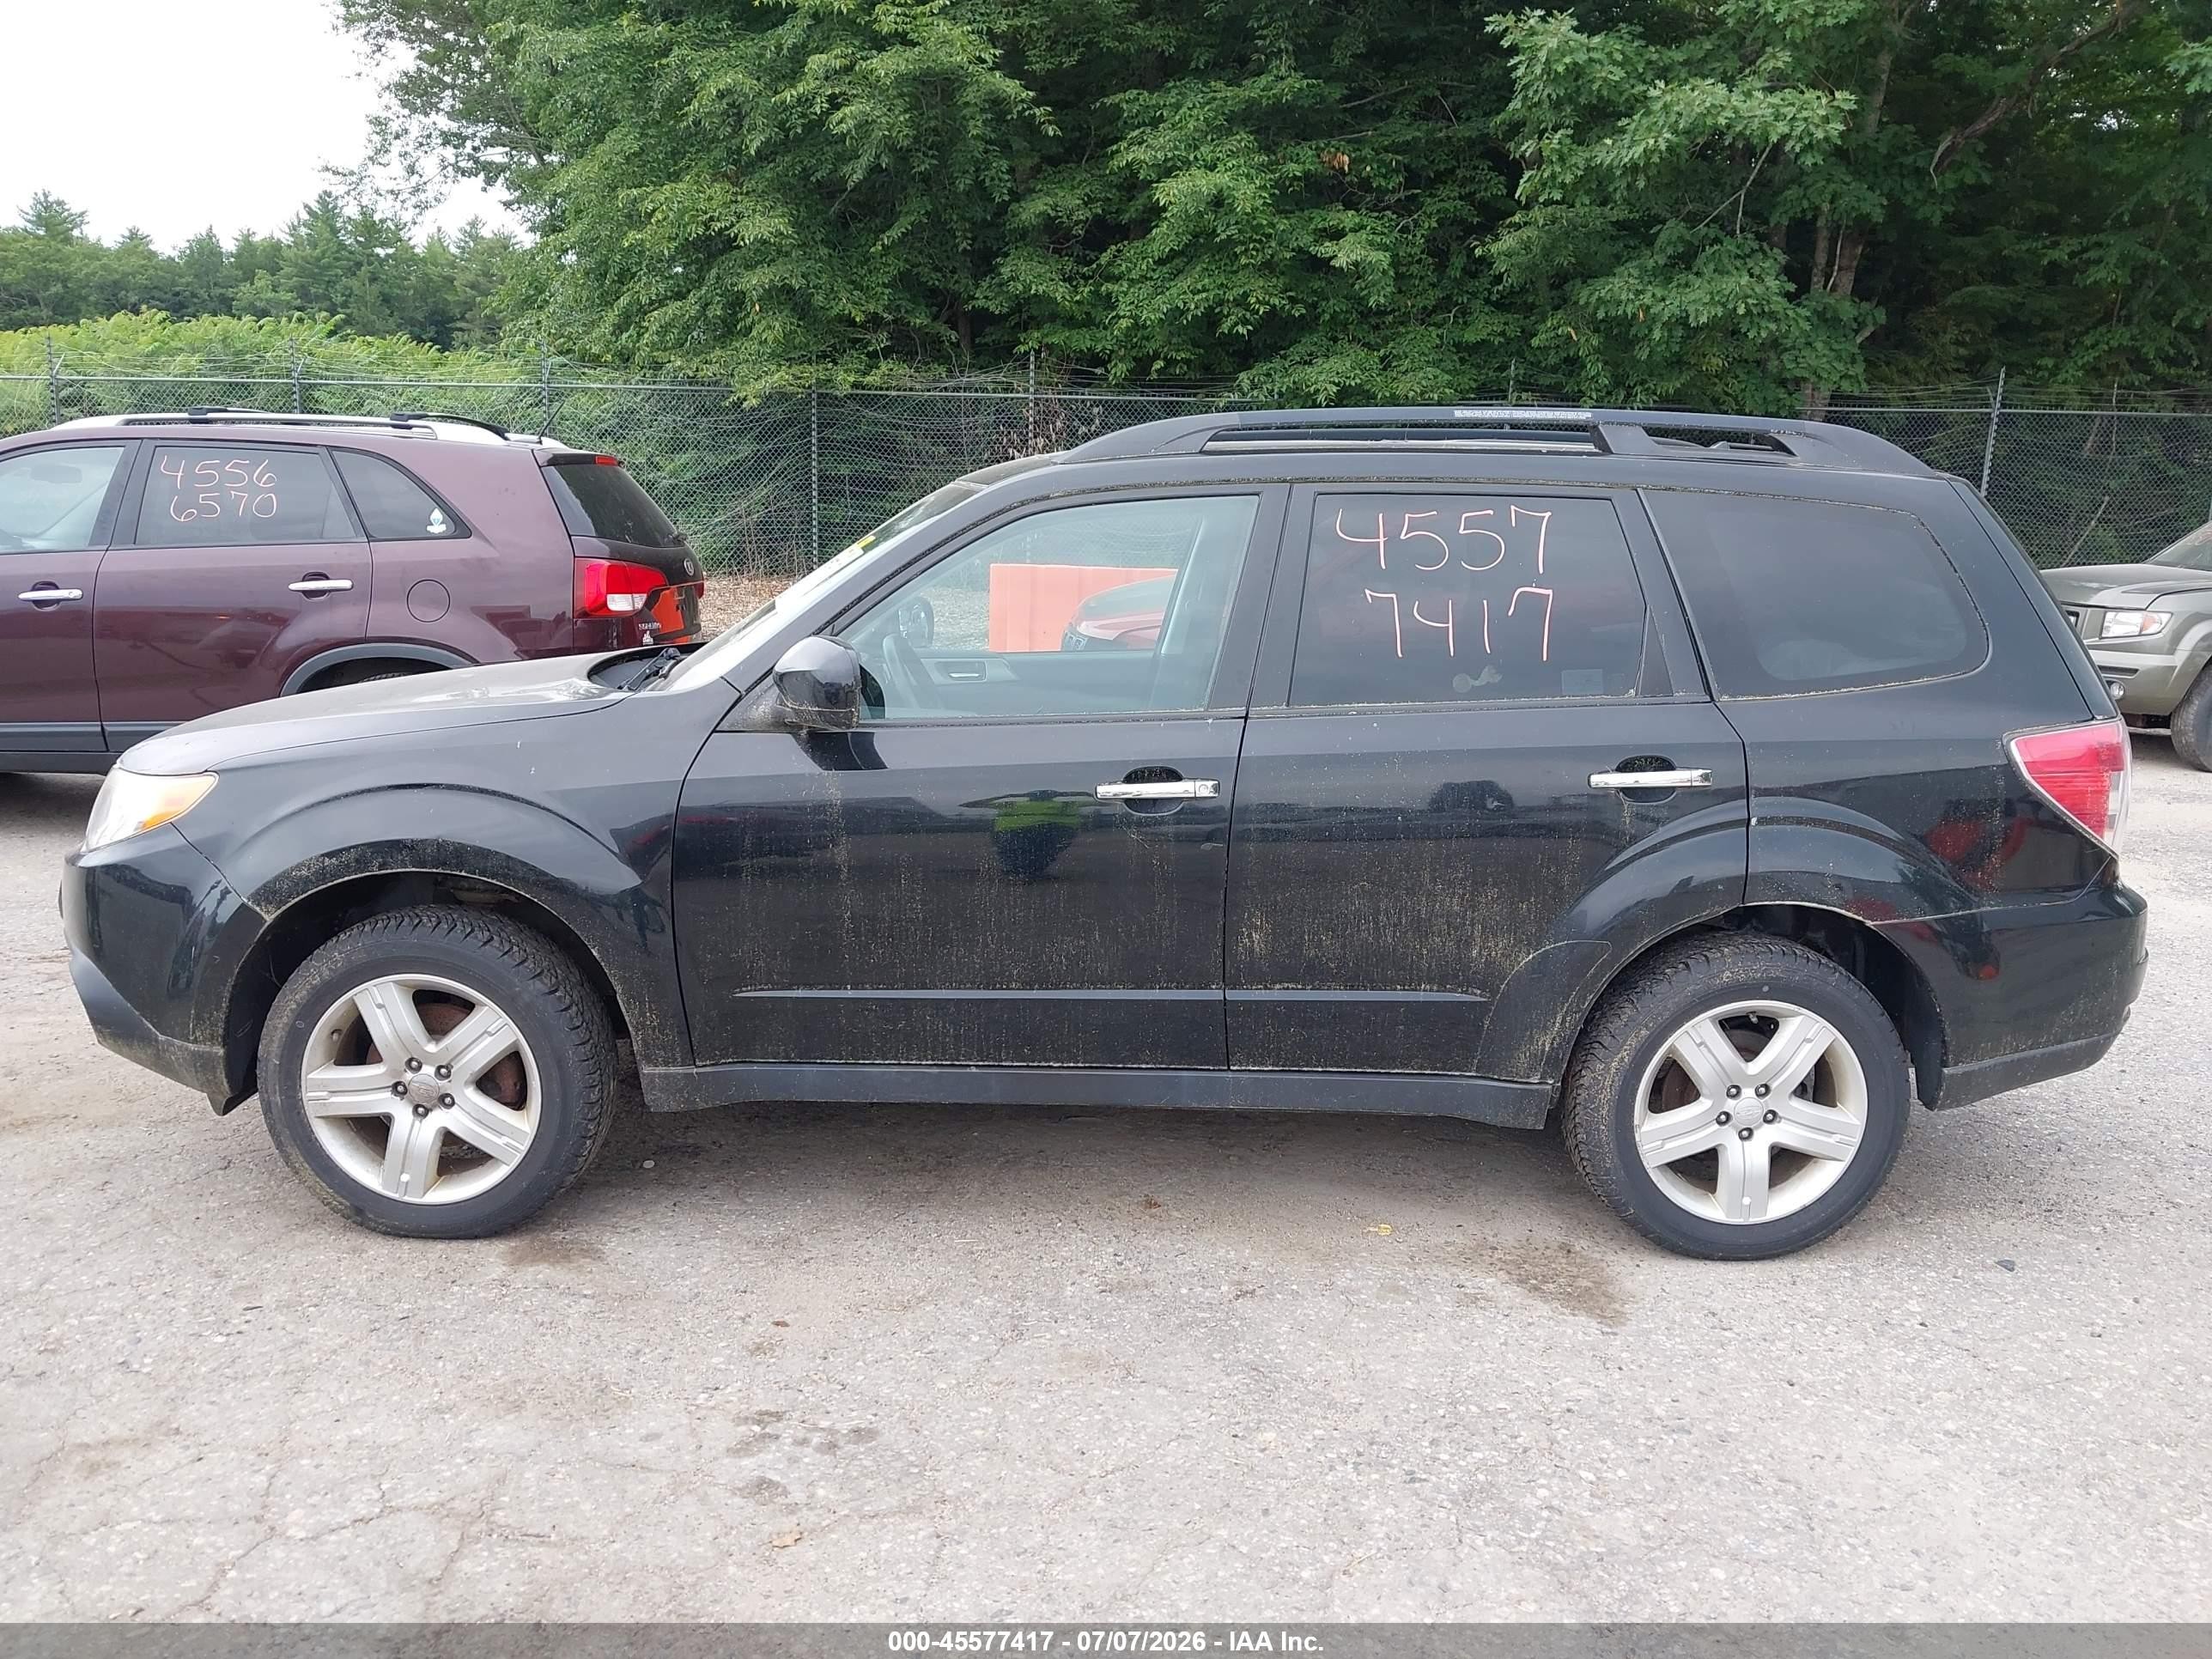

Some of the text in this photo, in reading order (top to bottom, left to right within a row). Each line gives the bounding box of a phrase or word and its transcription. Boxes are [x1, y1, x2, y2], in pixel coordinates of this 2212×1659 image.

[161, 455, 277, 489] 4556
[170, 490, 277, 522] 6570
[1335, 505, 1553, 574] 4557
[1364, 586, 1553, 661] 7417
